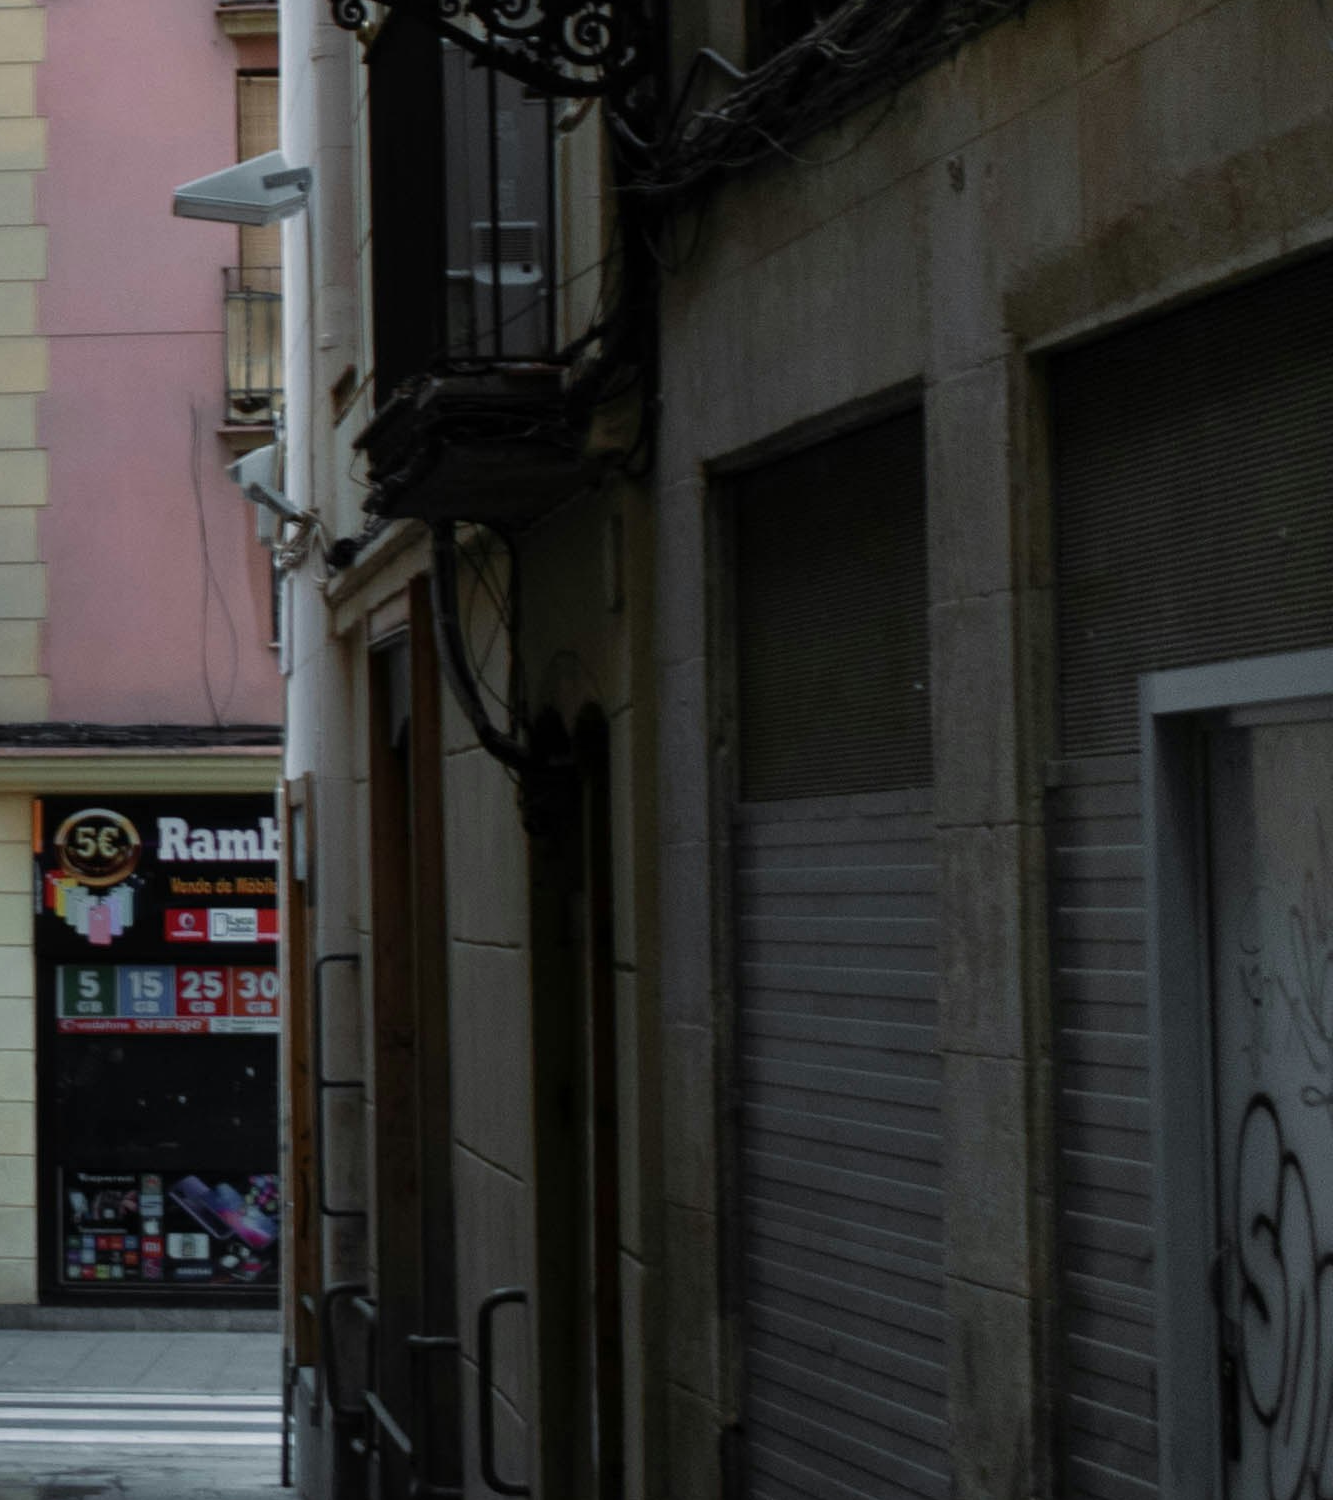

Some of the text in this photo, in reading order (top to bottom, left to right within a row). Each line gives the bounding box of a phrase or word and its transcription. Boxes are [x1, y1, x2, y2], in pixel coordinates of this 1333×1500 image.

[74, 826, 120, 858] 5€
[79, 970, 279, 999] 5 15 25 30
[76, 1001, 273, 1014] GB GB GB GB
